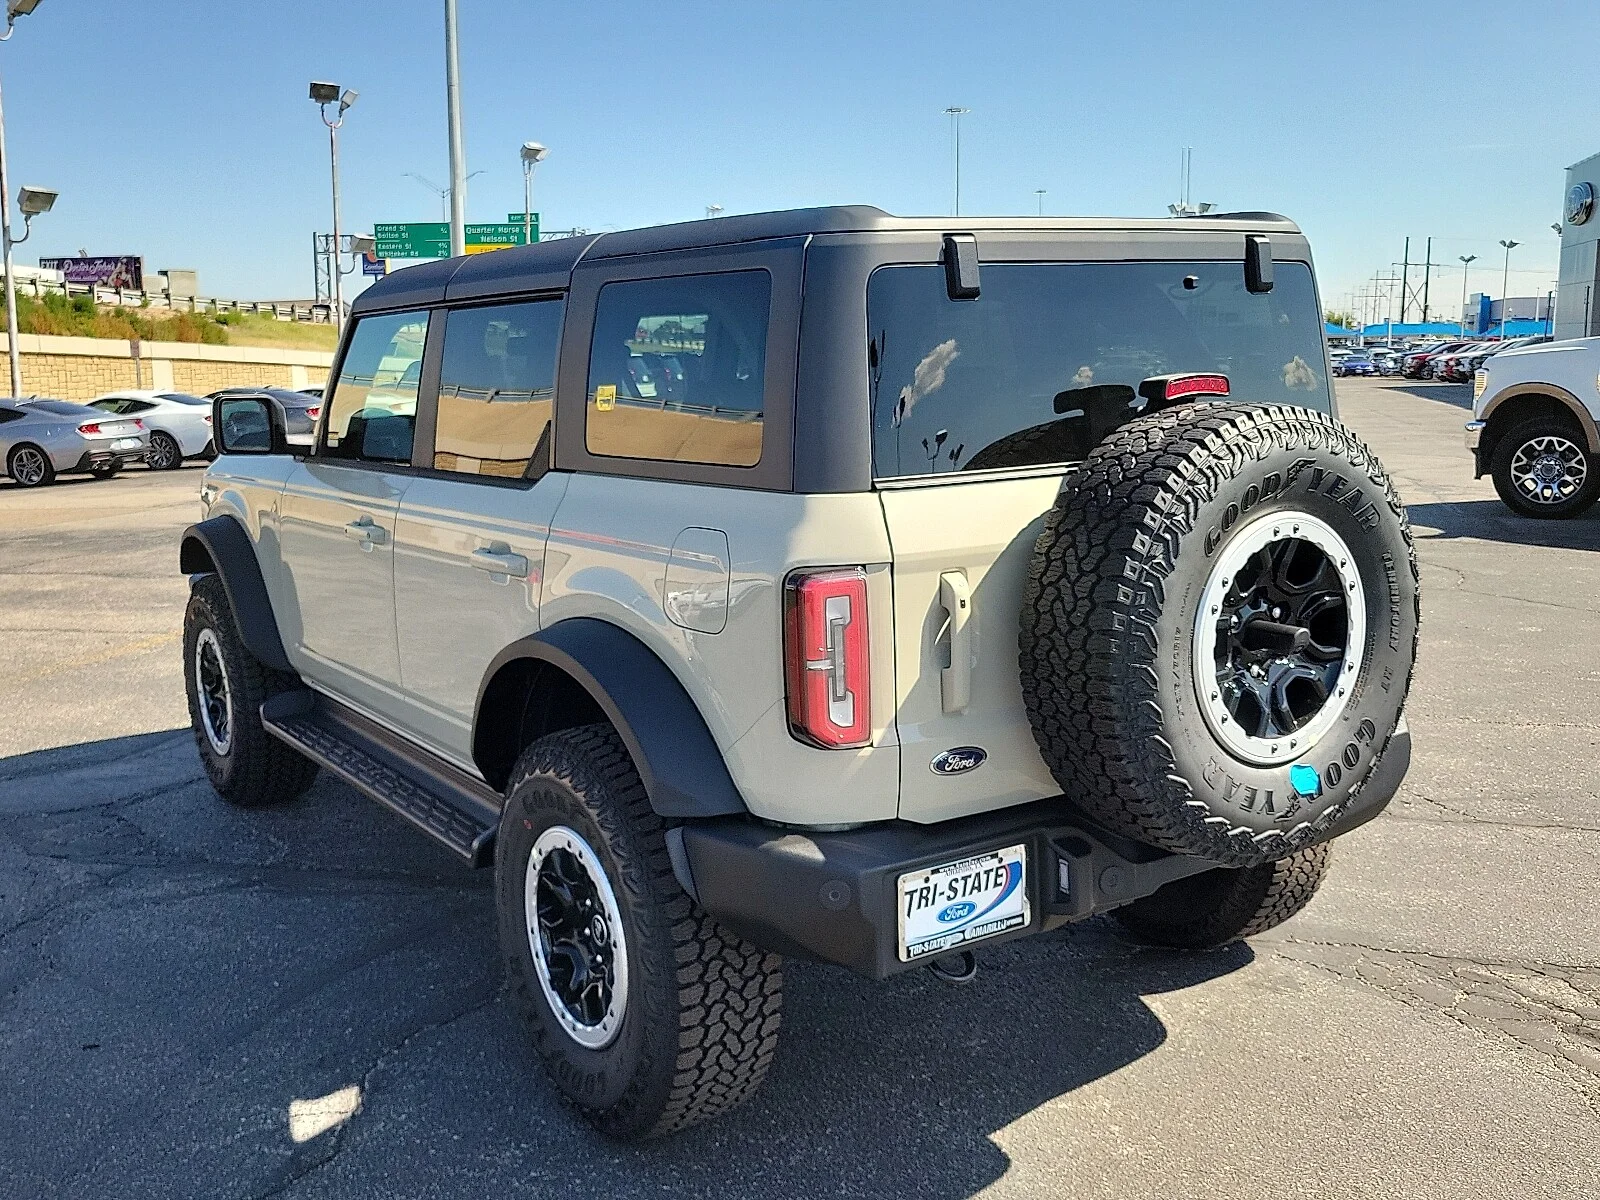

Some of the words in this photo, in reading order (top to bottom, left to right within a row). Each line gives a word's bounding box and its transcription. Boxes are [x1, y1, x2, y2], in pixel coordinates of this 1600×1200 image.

[466, 226, 495, 235] Quarter
[498, 226, 520, 234] Horse
[480, 235, 507, 243] Nelson
[509, 235, 518, 243] St
[904, 864, 1006, 919] TRI-STATE
[943, 903, 970, 922] Ford
[908, 935, 945, 957] TRI-STATE
